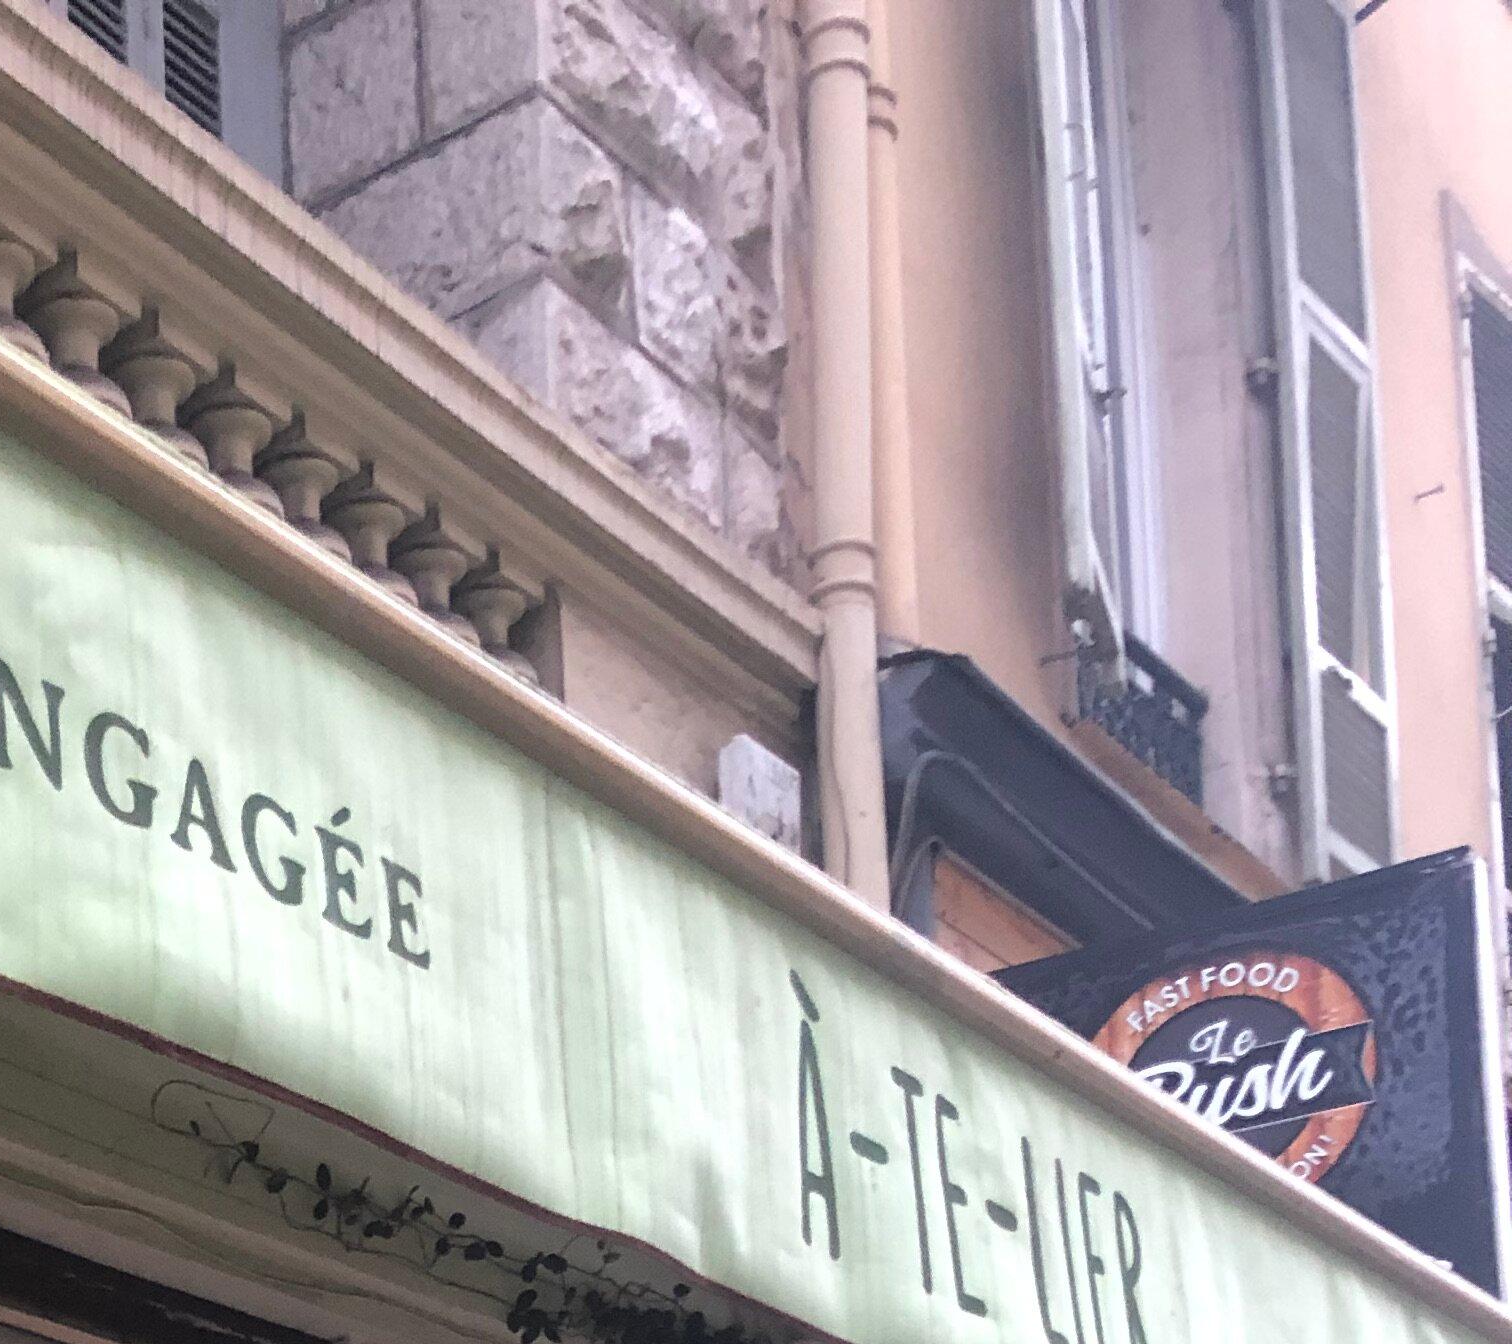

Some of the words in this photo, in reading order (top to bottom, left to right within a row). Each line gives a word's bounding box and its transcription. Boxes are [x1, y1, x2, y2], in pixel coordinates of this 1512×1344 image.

[1125, 975, 1192, 1033] FAST
[1199, 961, 1301, 993] FOOD
[1189, 1018, 1257, 1065] Le
